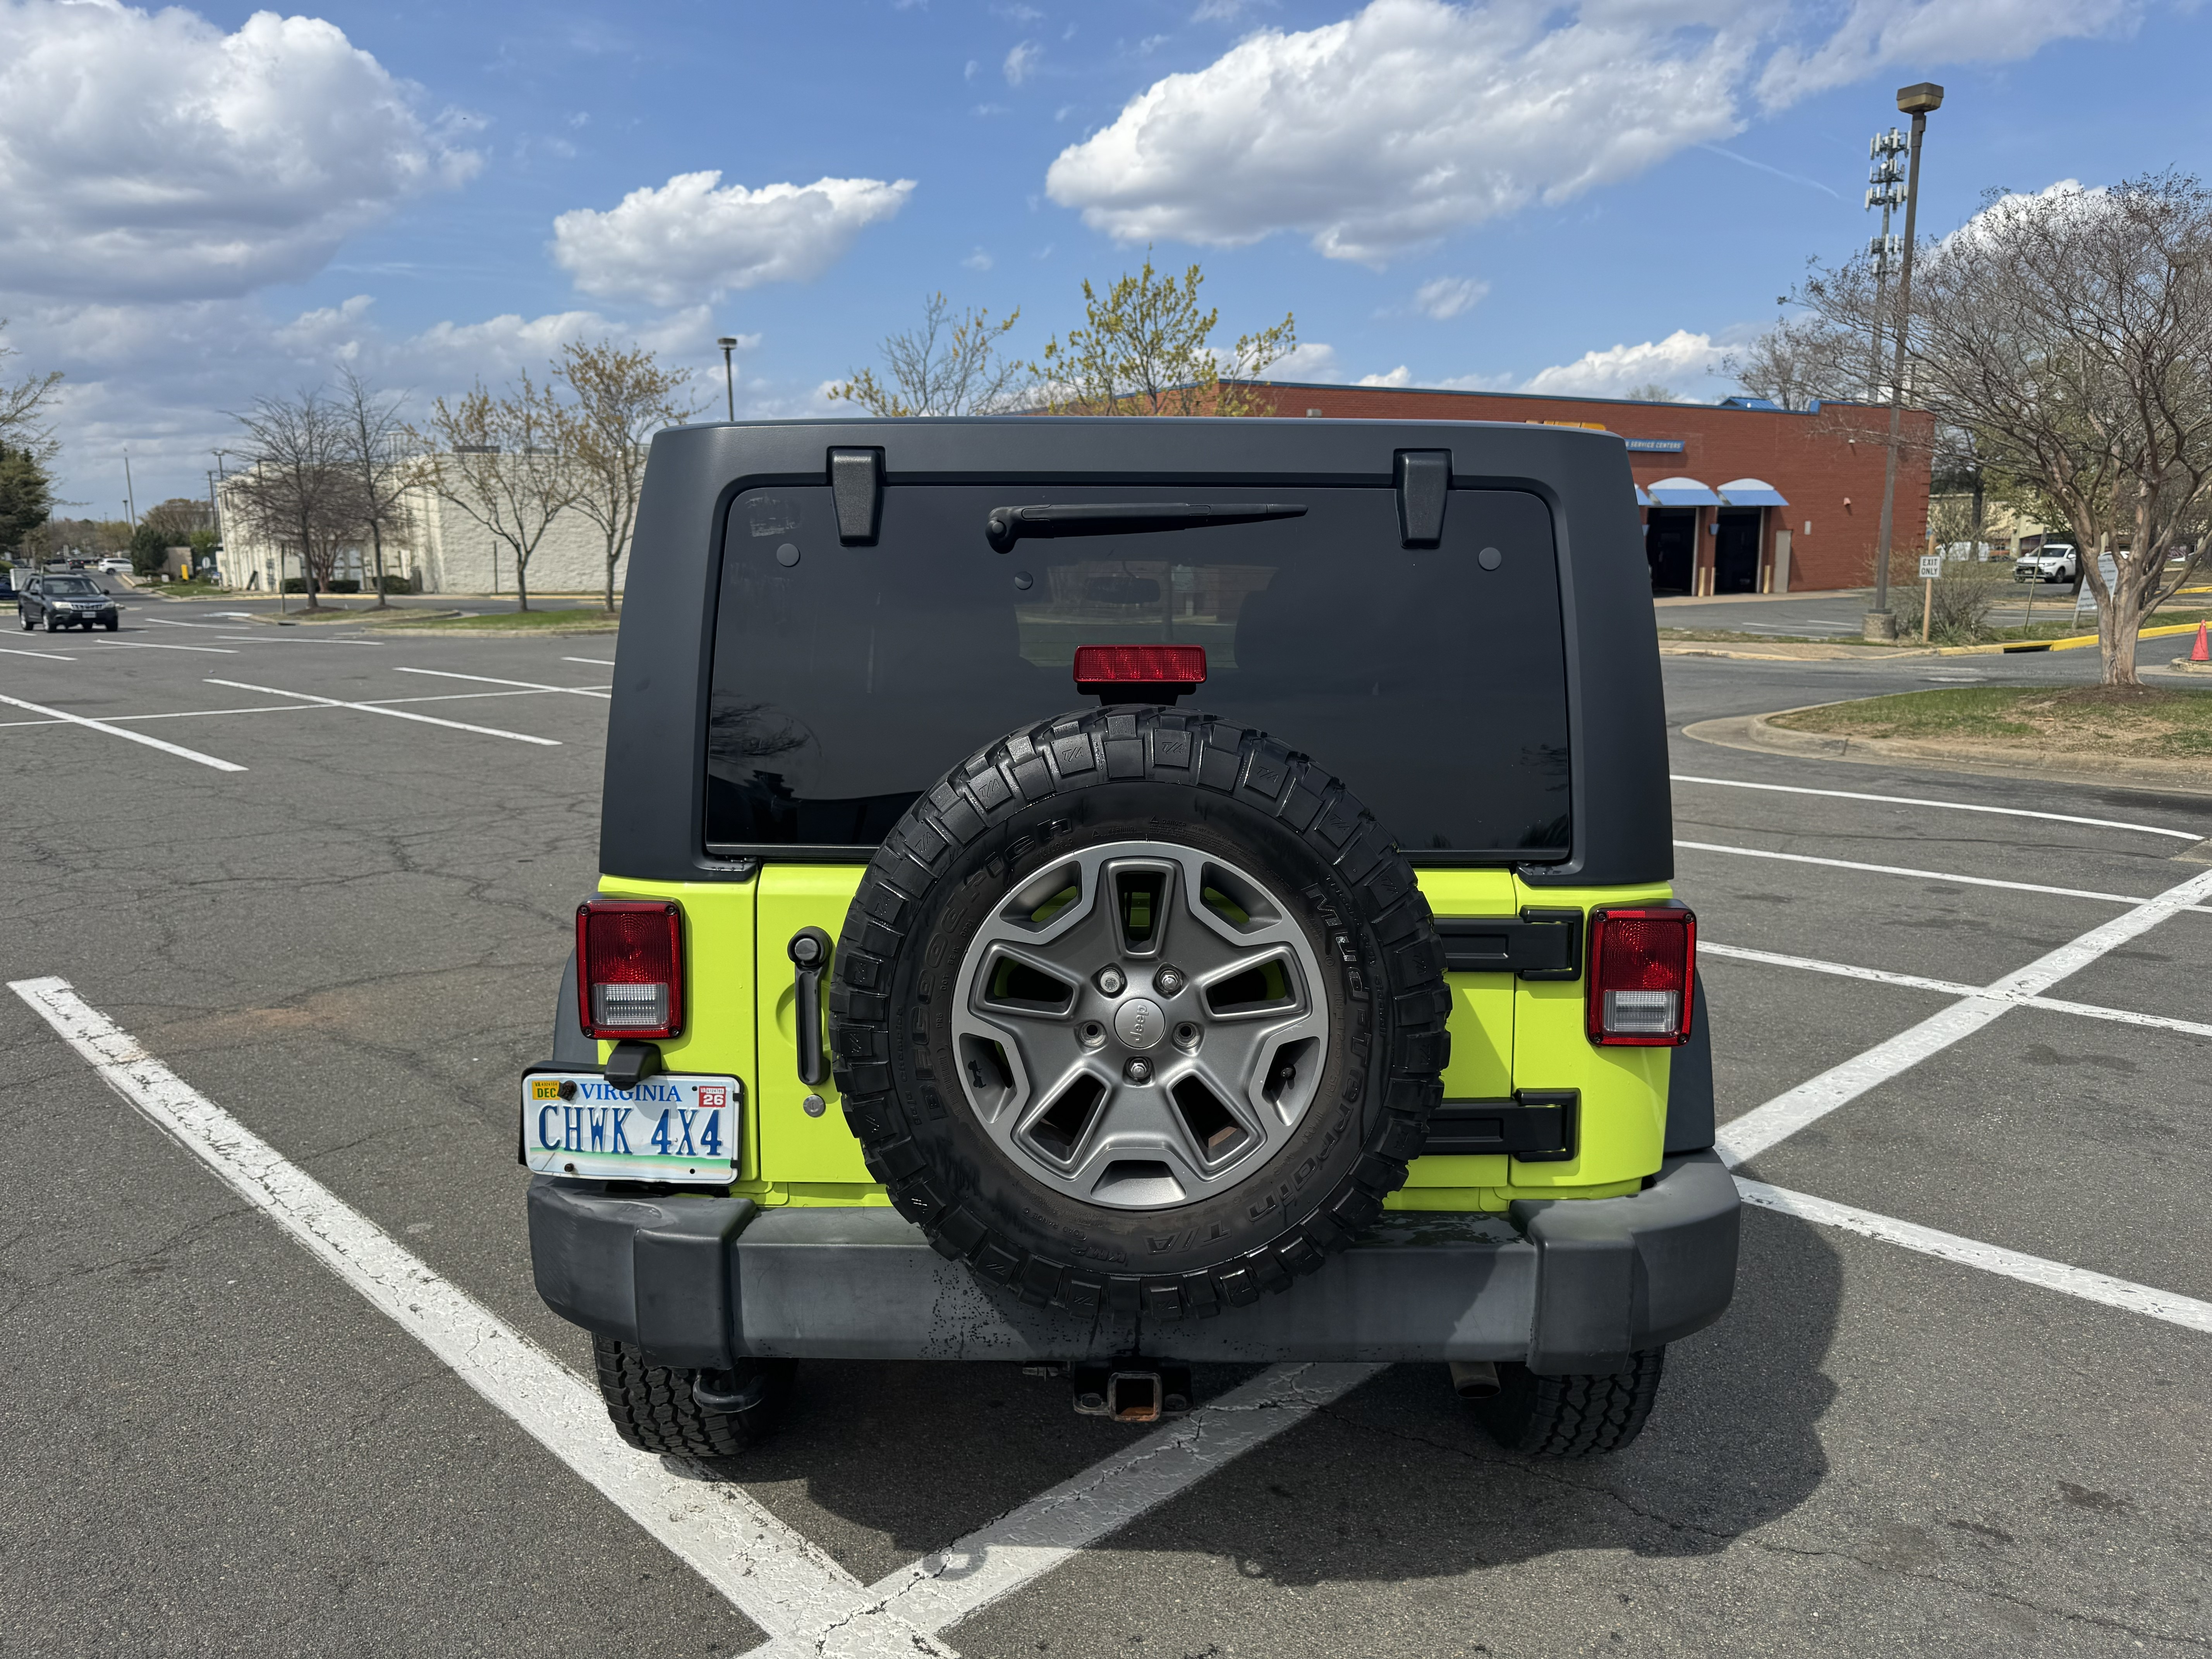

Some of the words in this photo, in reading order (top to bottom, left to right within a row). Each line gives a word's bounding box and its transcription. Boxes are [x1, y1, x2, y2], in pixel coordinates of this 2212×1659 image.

[1061, 745, 1084, 762] T/A
[1161, 741, 1184, 755] T/A
[1254, 765, 1279, 786] T/A
[977, 778, 1001, 799] T/A
[1328, 812, 1351, 836] T/A
[914, 831, 936, 854] T/A
[912, 817, 1074, 1120] BFGoodrich
[1130, 1005, 1149, 1043] Jeep
[537, 1088, 556, 1097] DEC
[580, 1084, 682, 1101] VIRGINIA
[703, 1094, 724, 1105] 26
[539, 1105, 632, 1154] CHWK
[651, 1109, 722, 1156] 4X4
[1031, 1211, 1060, 1230] RANGE
[1061, 1224, 1085, 1239] LOAD
[1143, 1217, 1233, 1255] T/A
[1068, 1242, 1127, 1264] KM2
